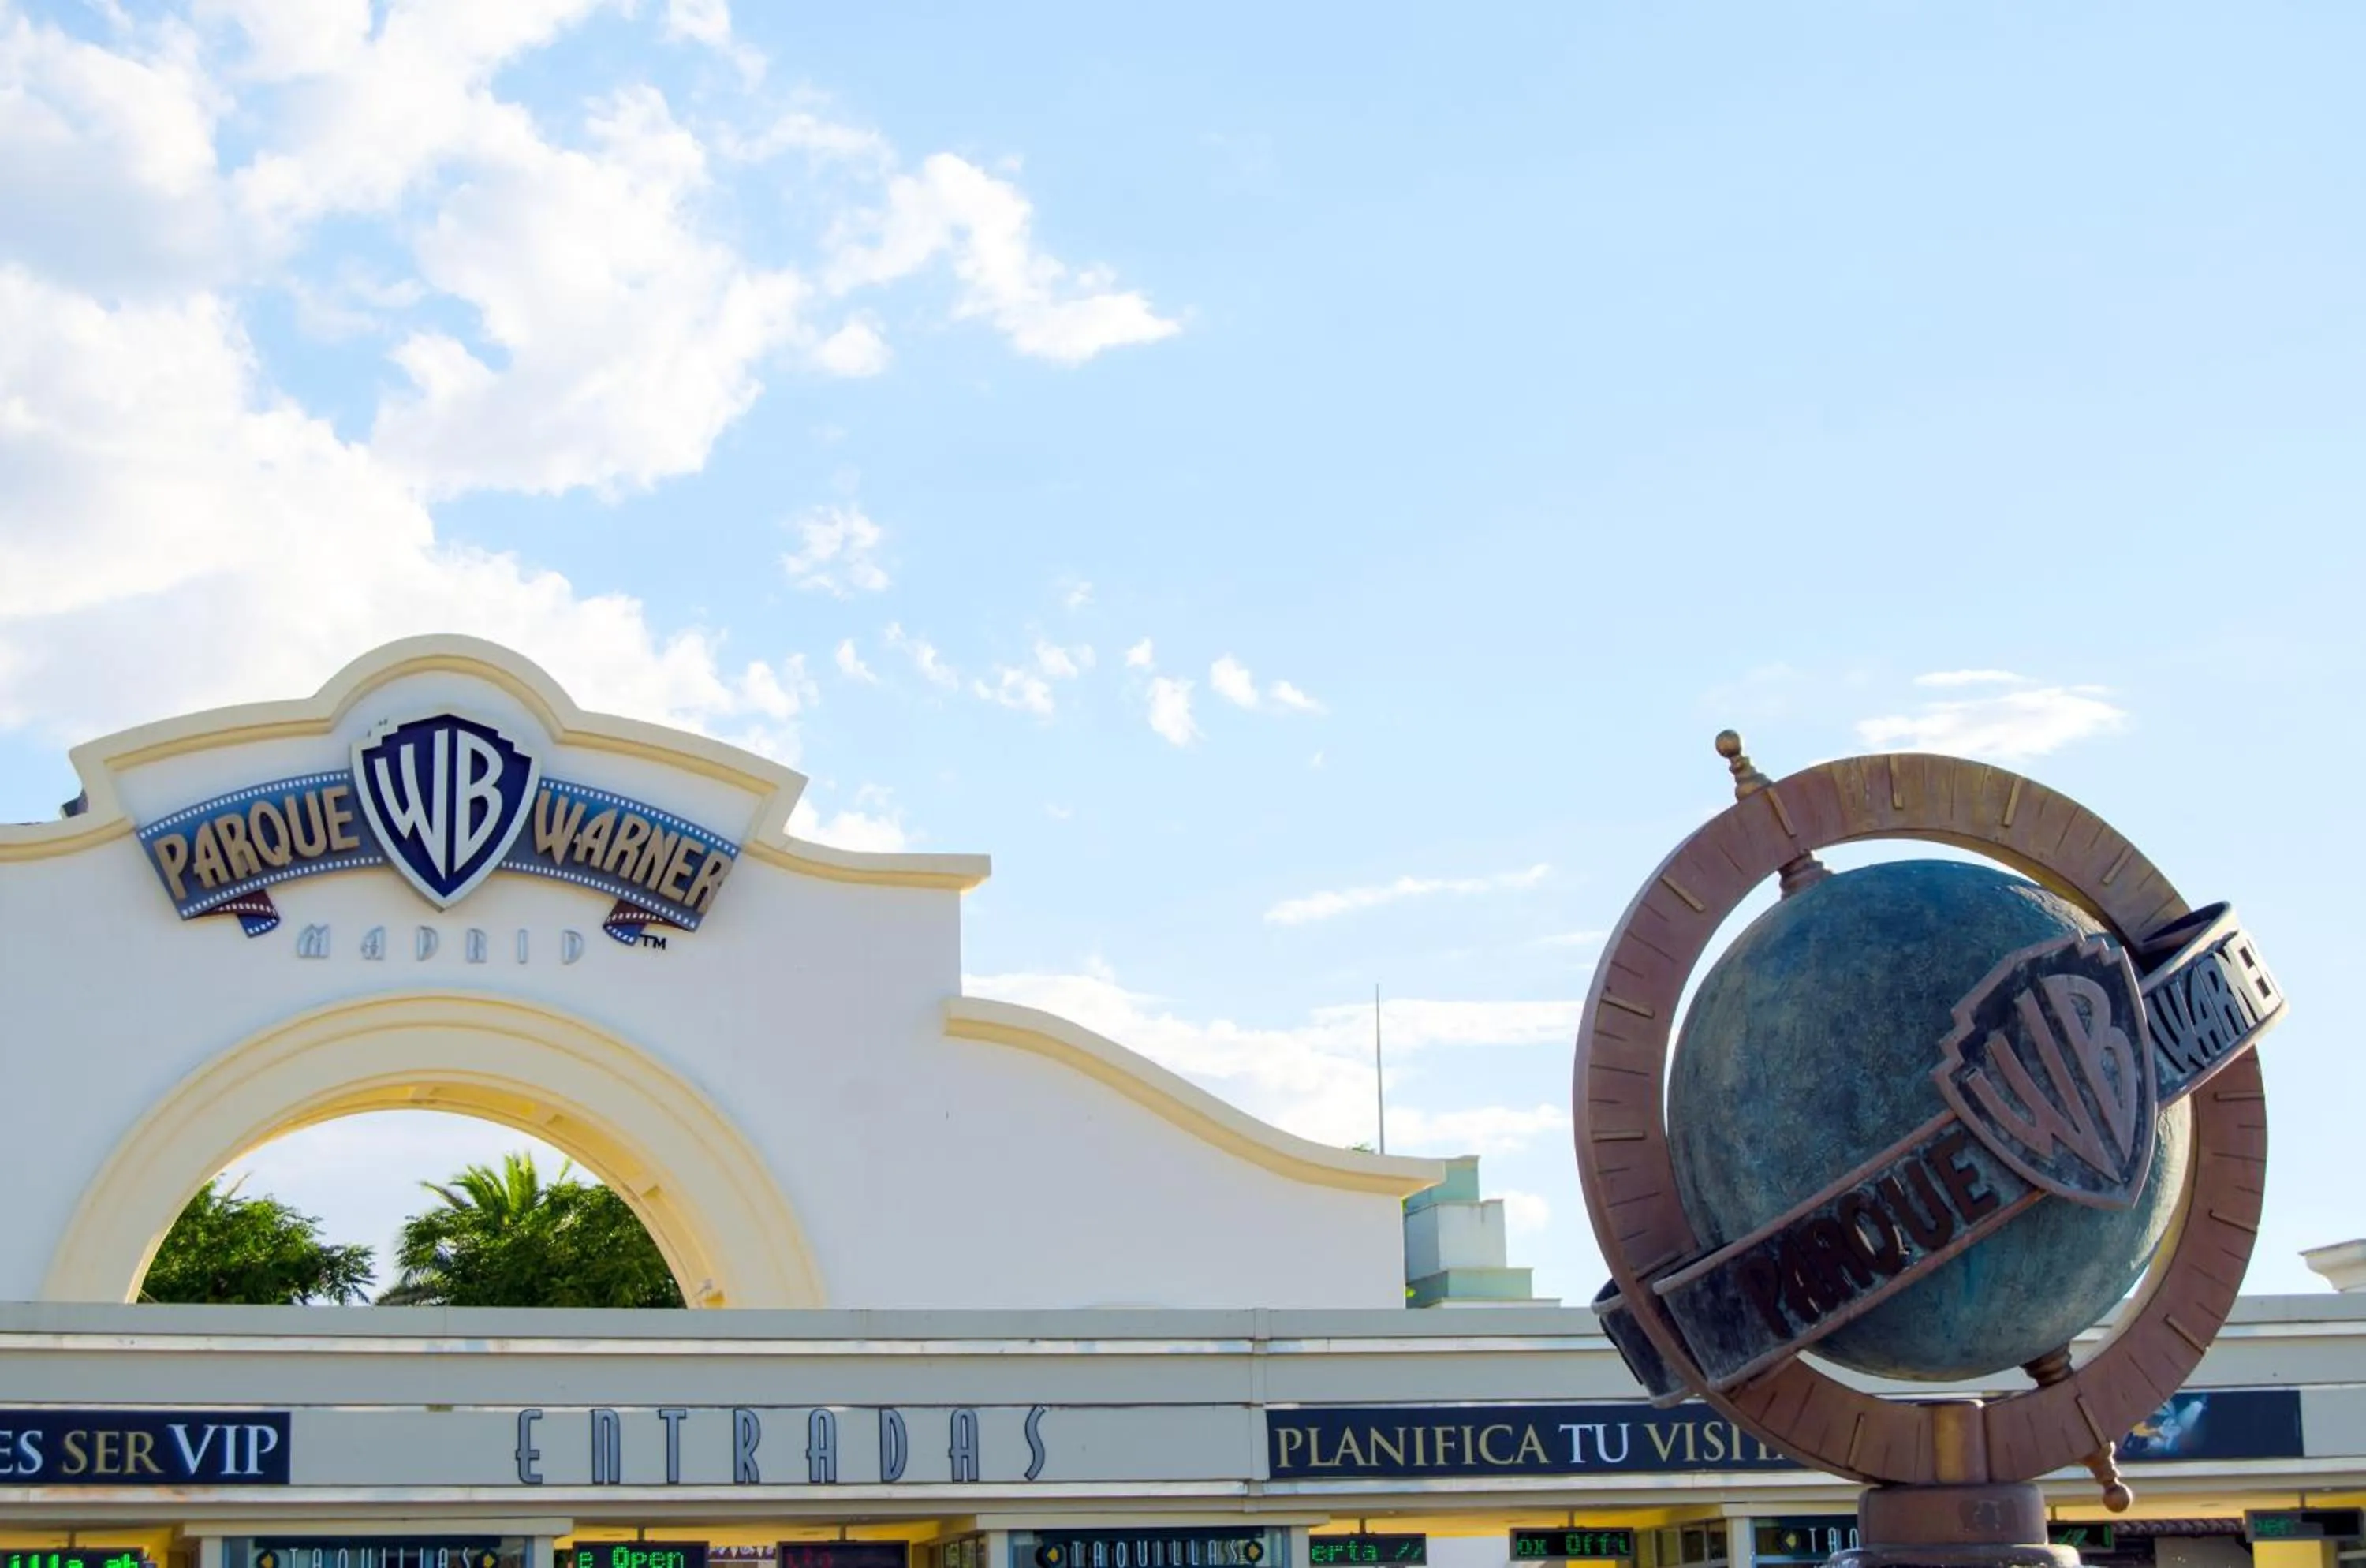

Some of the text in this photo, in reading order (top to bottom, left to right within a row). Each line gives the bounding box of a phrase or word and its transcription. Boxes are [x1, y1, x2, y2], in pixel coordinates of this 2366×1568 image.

[158, 729, 734, 912] PARQUE WB WARNER
[297, 923, 584, 965] MADRID
[641, 935, 666, 950] TM
[1739, 1130, 2001, 1339] PARQUE
[1967, 974, 2139, 1183] WB
[62, 1430, 163, 1474] SER
[166, 1424, 278, 1475] VIP
[516, 1405, 1046, 1485] ENTRADAS
[1274, 1421, 1786, 1469] PLANIFICA TU VISI
[613, 1547, 685, 1568] Open
[1312, 1540, 1378, 1562] erta
